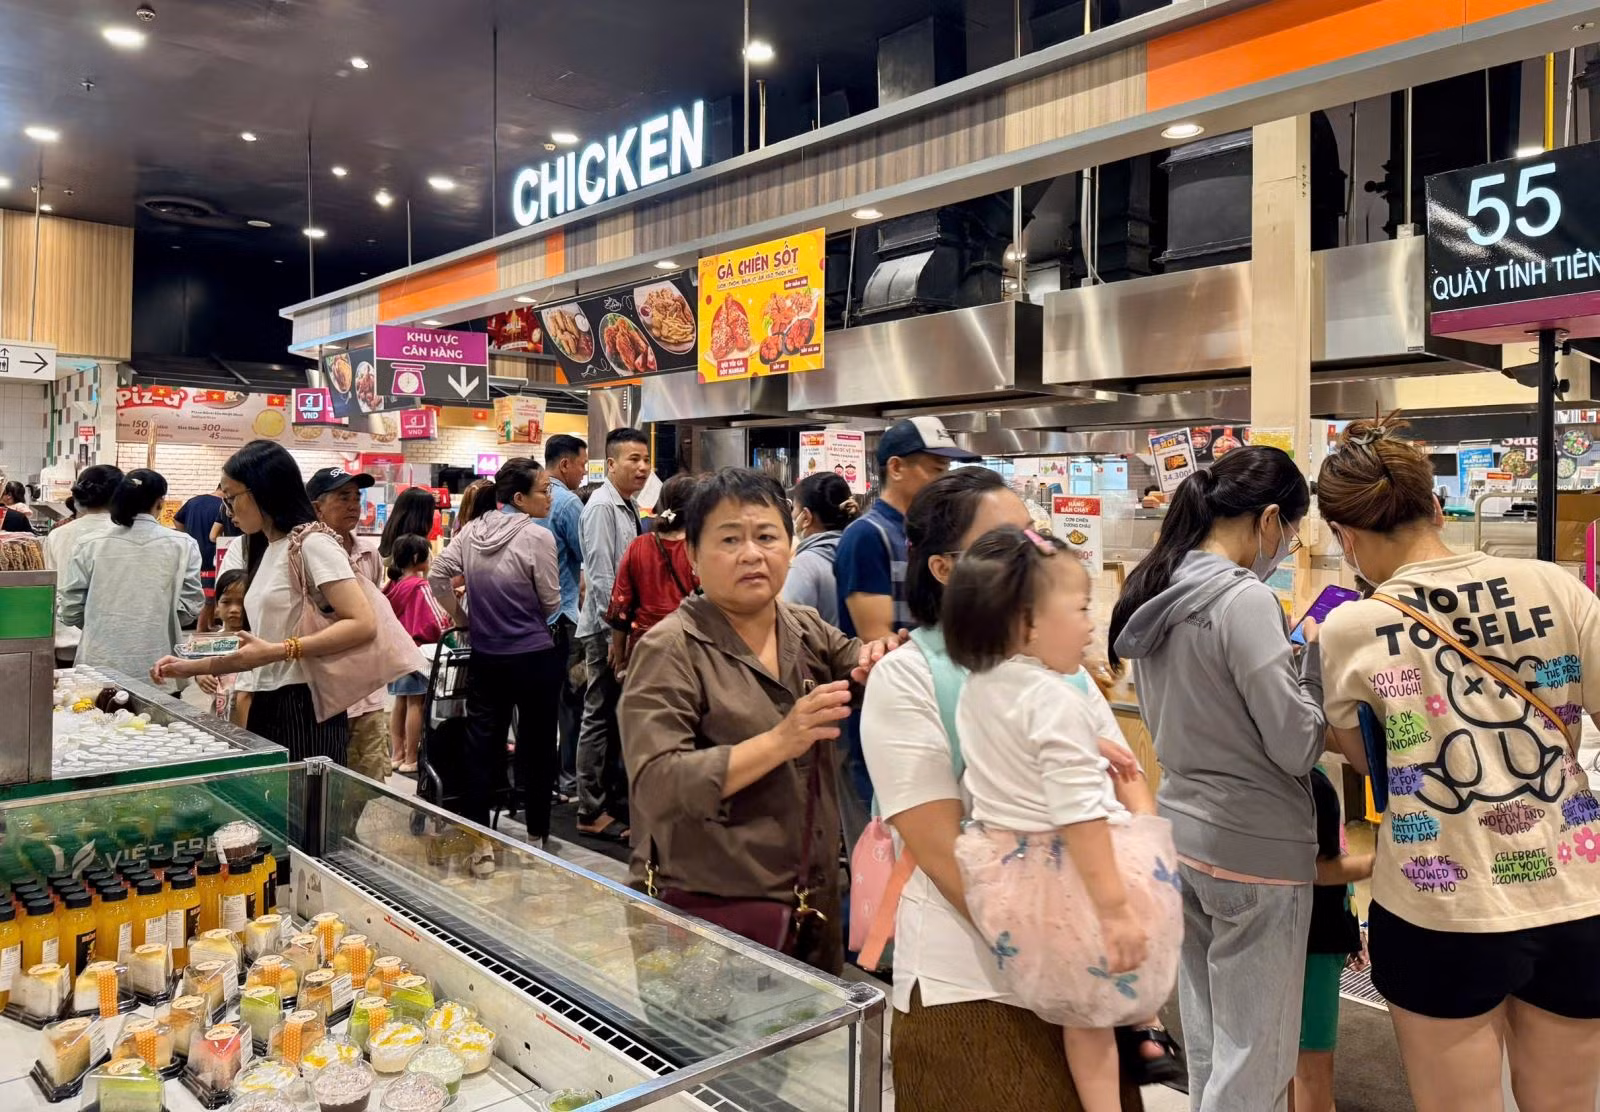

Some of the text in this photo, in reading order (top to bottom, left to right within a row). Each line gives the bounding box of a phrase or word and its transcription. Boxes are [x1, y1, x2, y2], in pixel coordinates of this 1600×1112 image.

[513, 99, 705, 227] CHICKEN
[1466, 162, 1561, 246] 55
[717, 241, 799, 280] GÀ CHIÊN SỐT
[1433, 248, 1600, 301] QUẦY TÍNH TIỀN
[407, 332, 459, 347] KHU VỰC
[402, 344, 463, 359] CÂN HÀNG
[302, 411, 319, 420] VND
[131, 419, 149, 429] 150
[201, 422, 221, 432] 300
[134, 429, 148, 437] 40
[209, 432, 221, 440] 45
[1398, 577, 1515, 618] NOTE
[1376, 605, 1554, 656] TO SELF
[1368, 668, 1421, 687] YOU ARE
[1544, 664, 1580, 681] THE BEST
[1547, 674, 1581, 691] YOU CAN
[1400, 709, 1413, 724] OK
[1399, 722, 1416, 737] SET
[1391, 766, 1405, 777] OK
[1400, 774, 1417, 786] FOR
[1580, 789, 1593, 801] TO
[1492, 799, 1529, 814] YOU'RE
[1577, 797, 1600, 813] OVER
[1478, 808, 1546, 827] WORTHY AND
[1499, 821, 1531, 836] LOVED
[1418, 831, 1438, 842] DAY
[1410, 854, 1452, 867] YOU'RE
[1495, 847, 1547, 863] CELEBRATE
[1490, 857, 1554, 874] WHAT YOU'VE
[1453, 868, 1468, 880] TO
[1415, 881, 1456, 893] SAY NO
